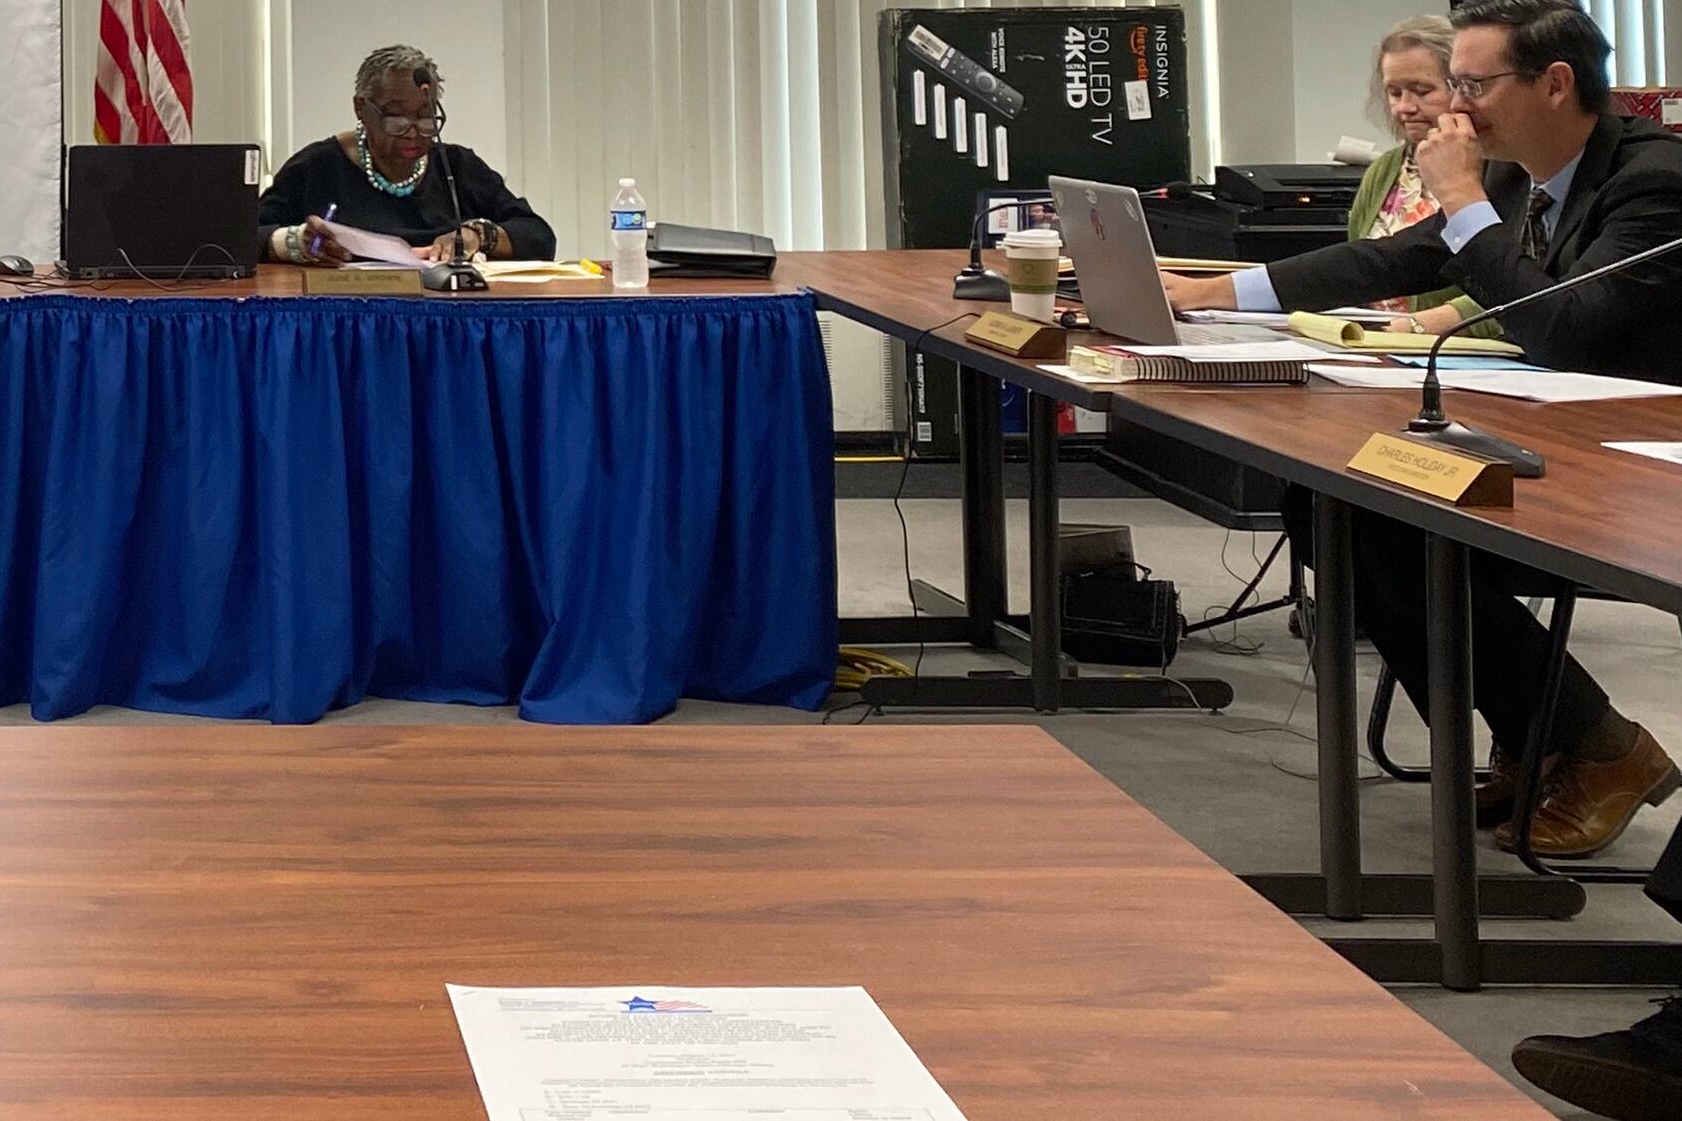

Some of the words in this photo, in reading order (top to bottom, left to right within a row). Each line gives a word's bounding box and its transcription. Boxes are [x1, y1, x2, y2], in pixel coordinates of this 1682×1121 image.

[1064, 26, 1087, 64] 4K
[1088, 26, 1110, 54] 50
[1155, 25, 1170, 98] INSIGNIA
[1066, 70, 1088, 111] HD
[1089, 61, 1112, 108] LED
[1091, 113, 1114, 146] TV
